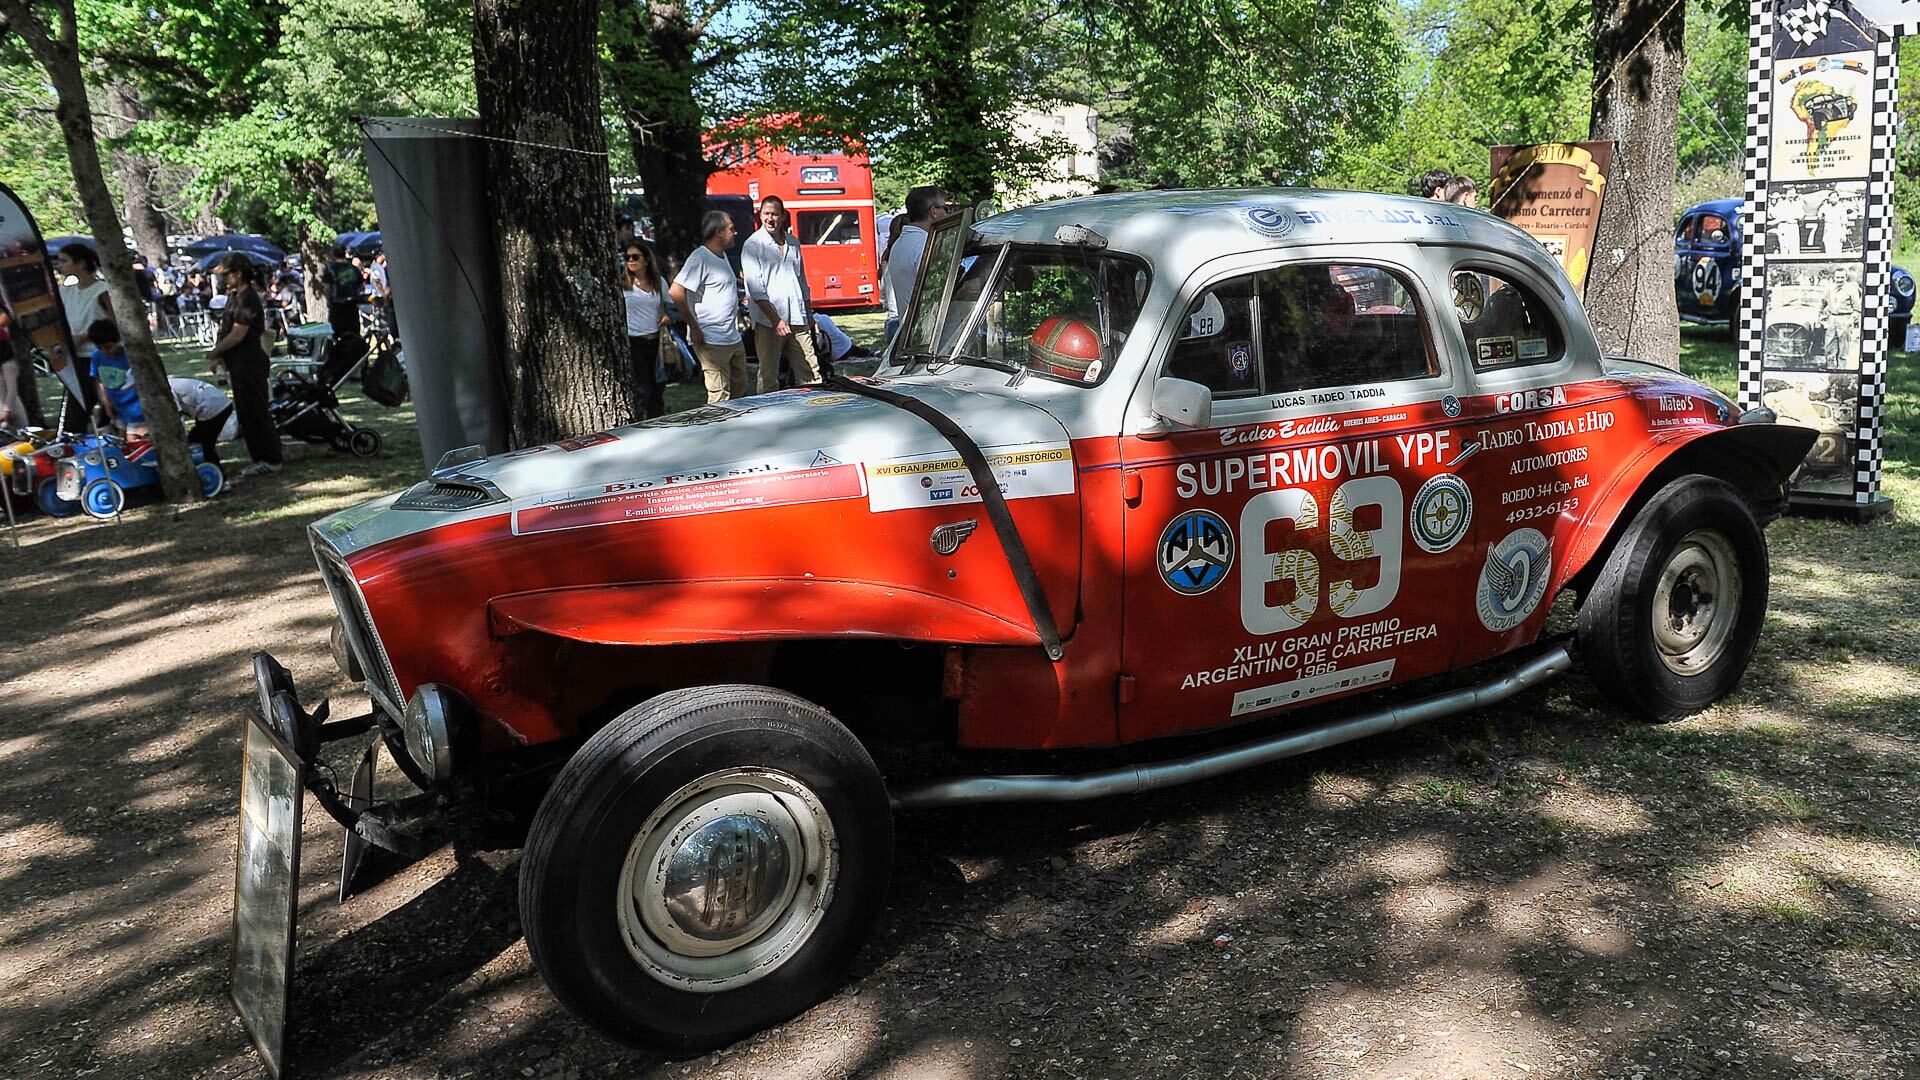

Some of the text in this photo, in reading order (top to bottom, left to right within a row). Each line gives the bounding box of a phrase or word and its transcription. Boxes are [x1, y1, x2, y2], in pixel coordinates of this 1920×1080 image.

[1574, 187, 1584, 199] el
[1540, 205, 1591, 217] Carretera
[1806, 222, 1819, 246] 7
[1694, 262, 1719, 294] 94
[1271, 387, 1386, 410] LUCAS TADEO TADDIA
[1495, 385, 1567, 414] CORSA
[1659, 395, 1694, 412] Mateo'S
[1382, 412, 1407, 423] CARACAS
[1478, 428, 1523, 451] TADEO
[1525, 416, 1574, 442] TADDIA
[1585, 411, 1615, 431] HIJO
[1015, 450, 1063, 463] HISTÓRICO
[1509, 446, 1588, 475] AUTOMOTORES
[1817, 436, 1836, 462] 2
[107, 458, 118, 469] 3
[875, 467, 891, 476] XVI
[893, 464, 921, 474] GRAN
[922, 460, 959, 471] PREMIO
[1176, 430, 1451, 499] SUPERMOVIL YPF
[549, 496, 616, 512] Mantenimiento
[617, 495, 624, 503] y
[625, 490, 660, 500] servicio
[660, 487, 691, 498] técnico
[692, 484, 703, 492] de
[704, 478, 761, 492] equipamiento
[783, 469, 830, 482] laboratorio
[602, 464, 780, 494] Bio Fab s.r.l.
[1501, 474, 1590, 505] BOEDO 344 Cap. Fed.
[647, 488, 740, 504] Insumos hospitalarios
[931, 490, 951, 499] YPF
[625, 506, 657, 517] E-mail:
[1505, 497, 1580, 524] 4932-6153
[1240, 475, 1403, 635] 69
[1523, 578, 1547, 615] CLUB
[1232, 617, 1401, 664] XLIV GRAN PREMIO
[1180, 623, 1438, 690] ARGENTINO DE CARRETERA
[1295, 661, 1338, 681] 1966
